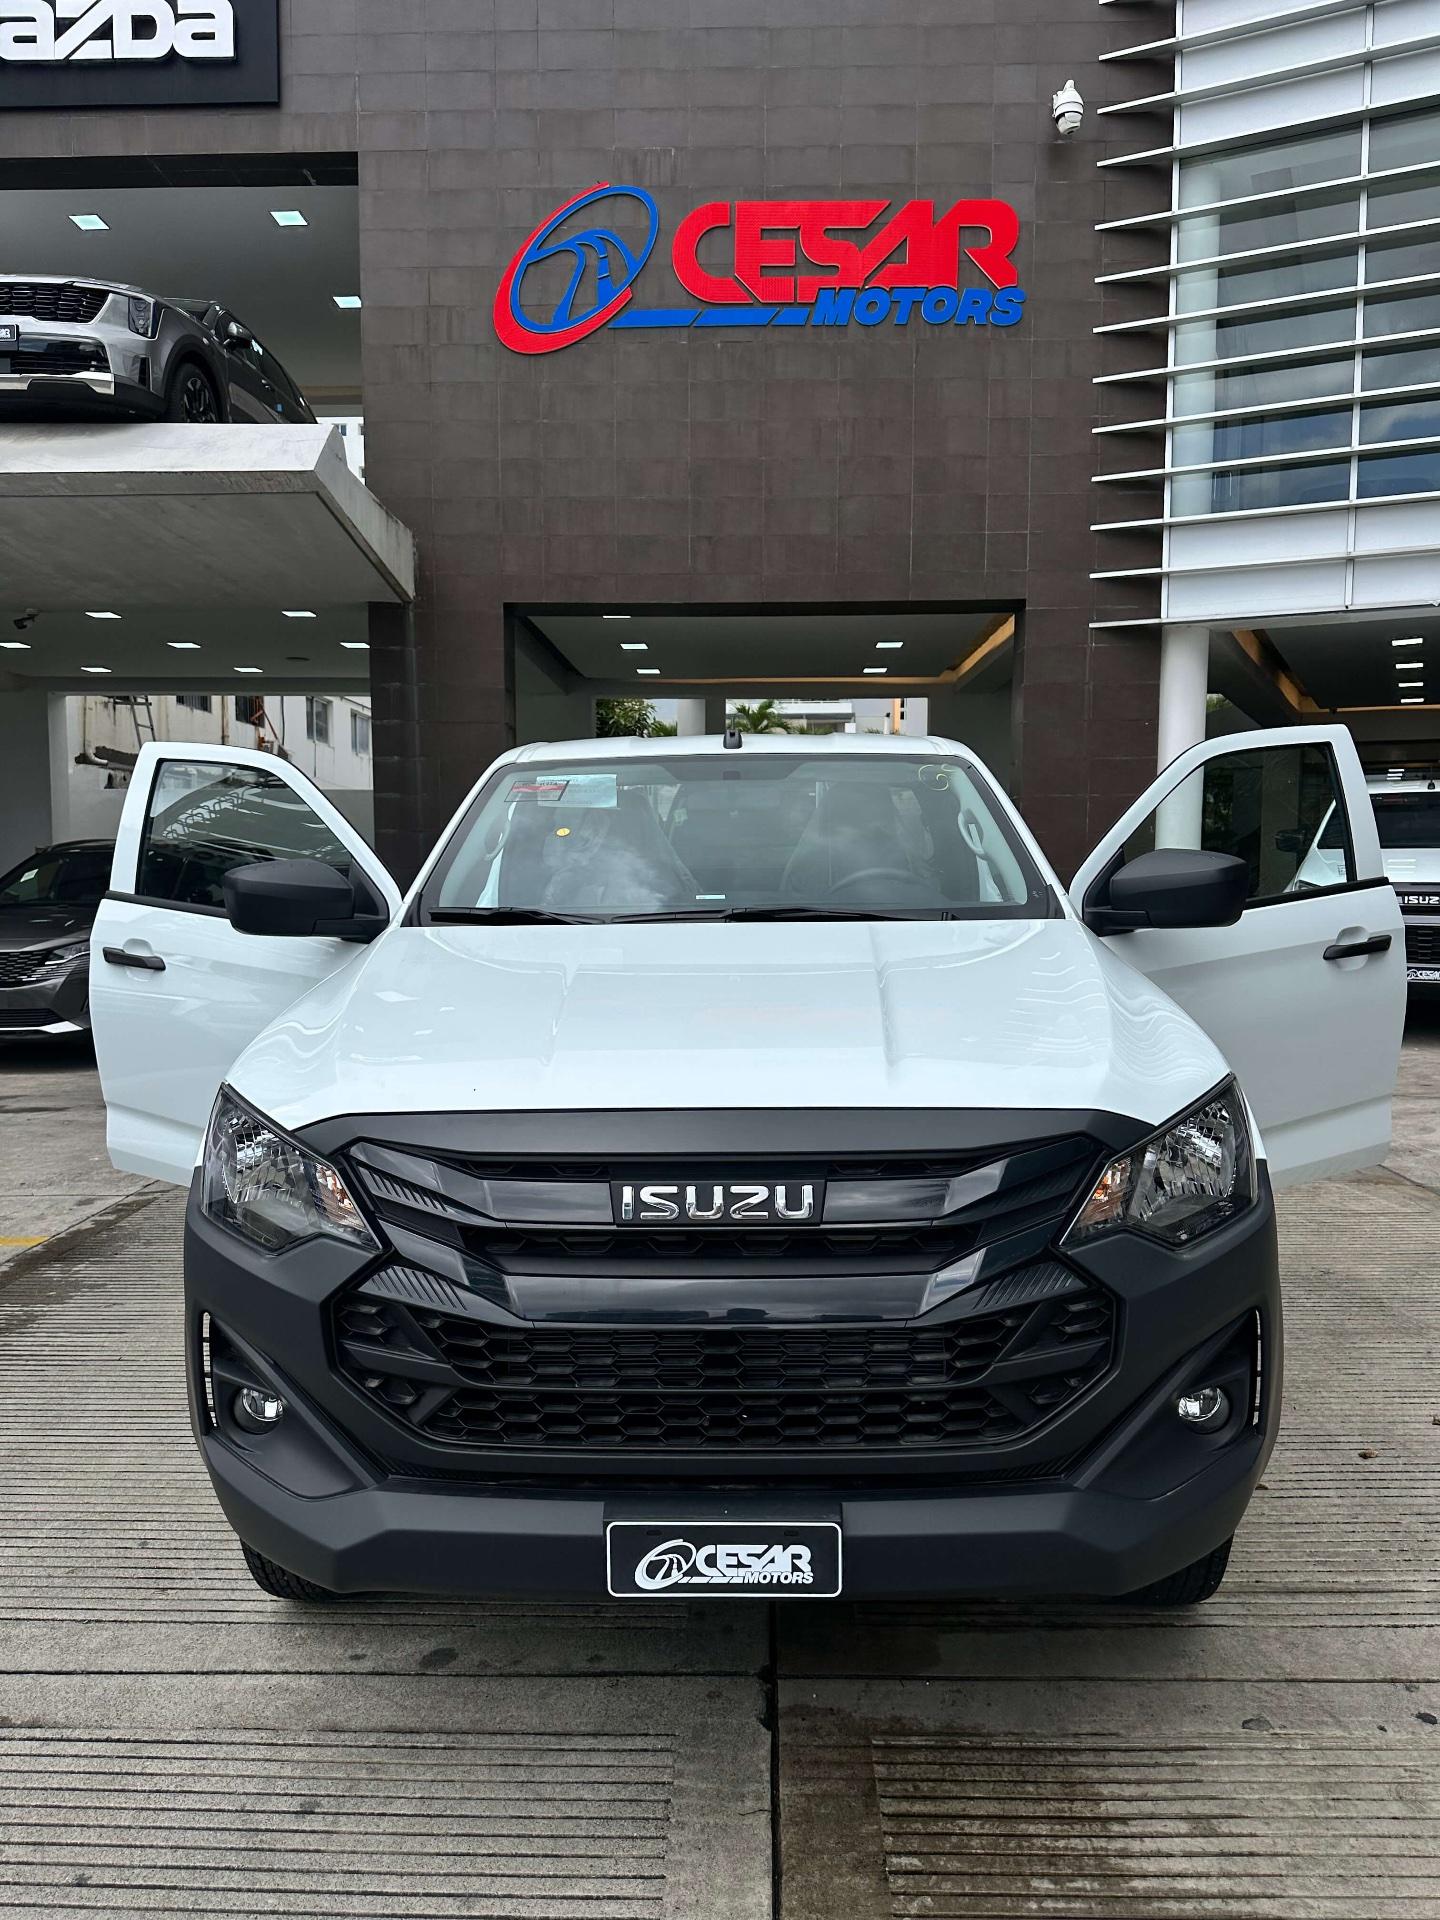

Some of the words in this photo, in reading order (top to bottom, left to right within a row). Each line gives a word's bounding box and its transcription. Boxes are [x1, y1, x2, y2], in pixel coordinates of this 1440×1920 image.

[672, 199, 1019, 304] CESAR
[810, 286, 1026, 328] MOTORS
[622, 1185, 814, 1220] ISUZU
[695, 1544, 812, 1577] CESAR
[743, 1570, 814, 1584] MOTORS
